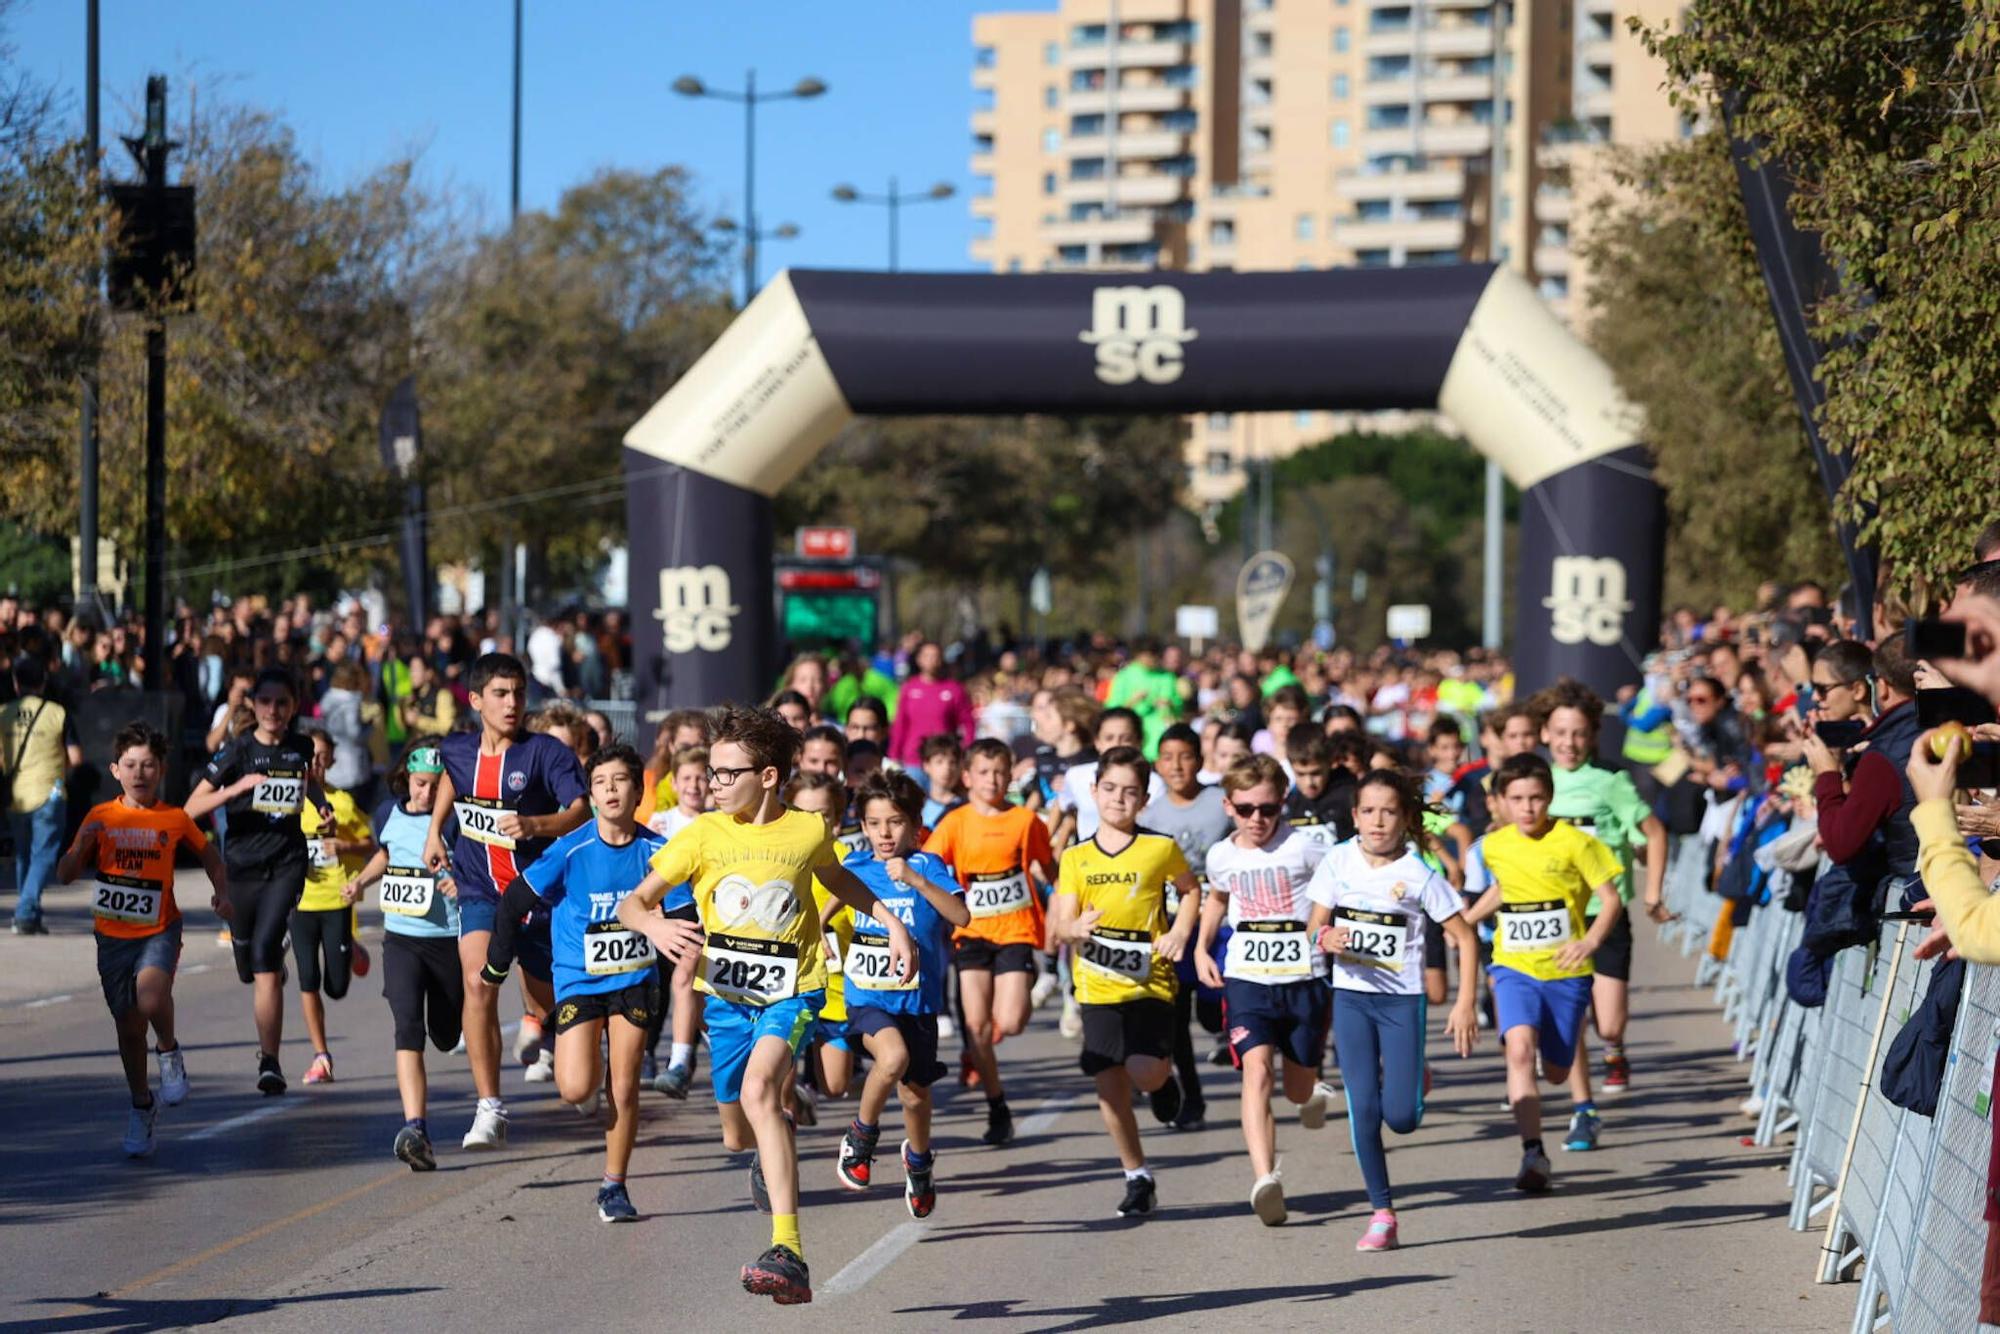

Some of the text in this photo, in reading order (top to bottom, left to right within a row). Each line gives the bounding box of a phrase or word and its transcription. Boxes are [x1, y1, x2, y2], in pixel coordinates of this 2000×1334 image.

[463, 808, 507, 837] 202
[115, 848, 161, 860] RUNNING
[116, 859, 143, 870] TEAM
[97, 888, 153, 915] 2023
[383, 881, 426, 905] 2023
[974, 881, 1024, 907] 2023
[1508, 918, 1563, 941] 2023
[592, 934, 649, 962] 2023
[1245, 940, 1301, 962] 2023
[1346, 929, 1397, 957] 023
[1083, 942, 1142, 971] 2023
[713, 957, 786, 993] 2023
